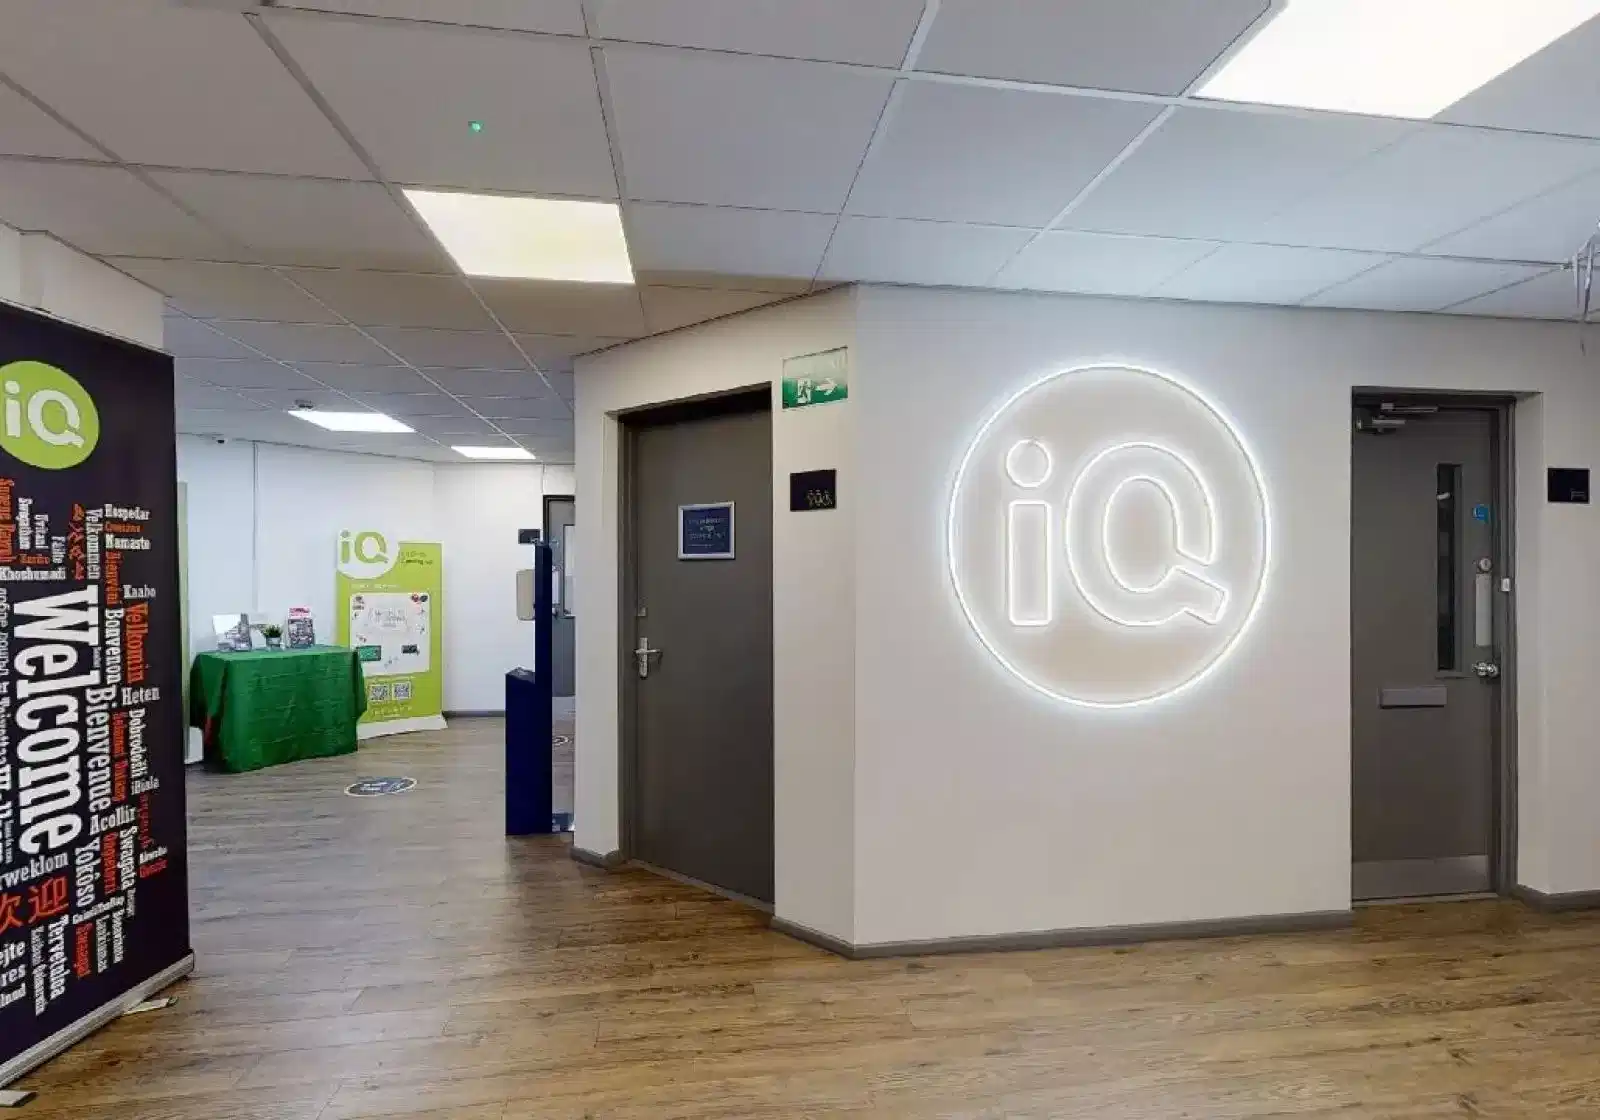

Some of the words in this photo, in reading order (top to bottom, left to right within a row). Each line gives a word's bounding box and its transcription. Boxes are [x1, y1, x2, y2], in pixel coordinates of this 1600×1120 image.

[4, 380, 85, 448] iQ
[340, 529, 390, 564] iQ
[1005, 438, 1229, 627] iQ
[106, 608, 124, 685] Bonvenon
[125, 601, 149, 684] Velkomin
[14, 585, 100, 855] Welcome
[86, 684, 117, 813] Bienvenue
[75, 836, 102, 908] Yokôso
